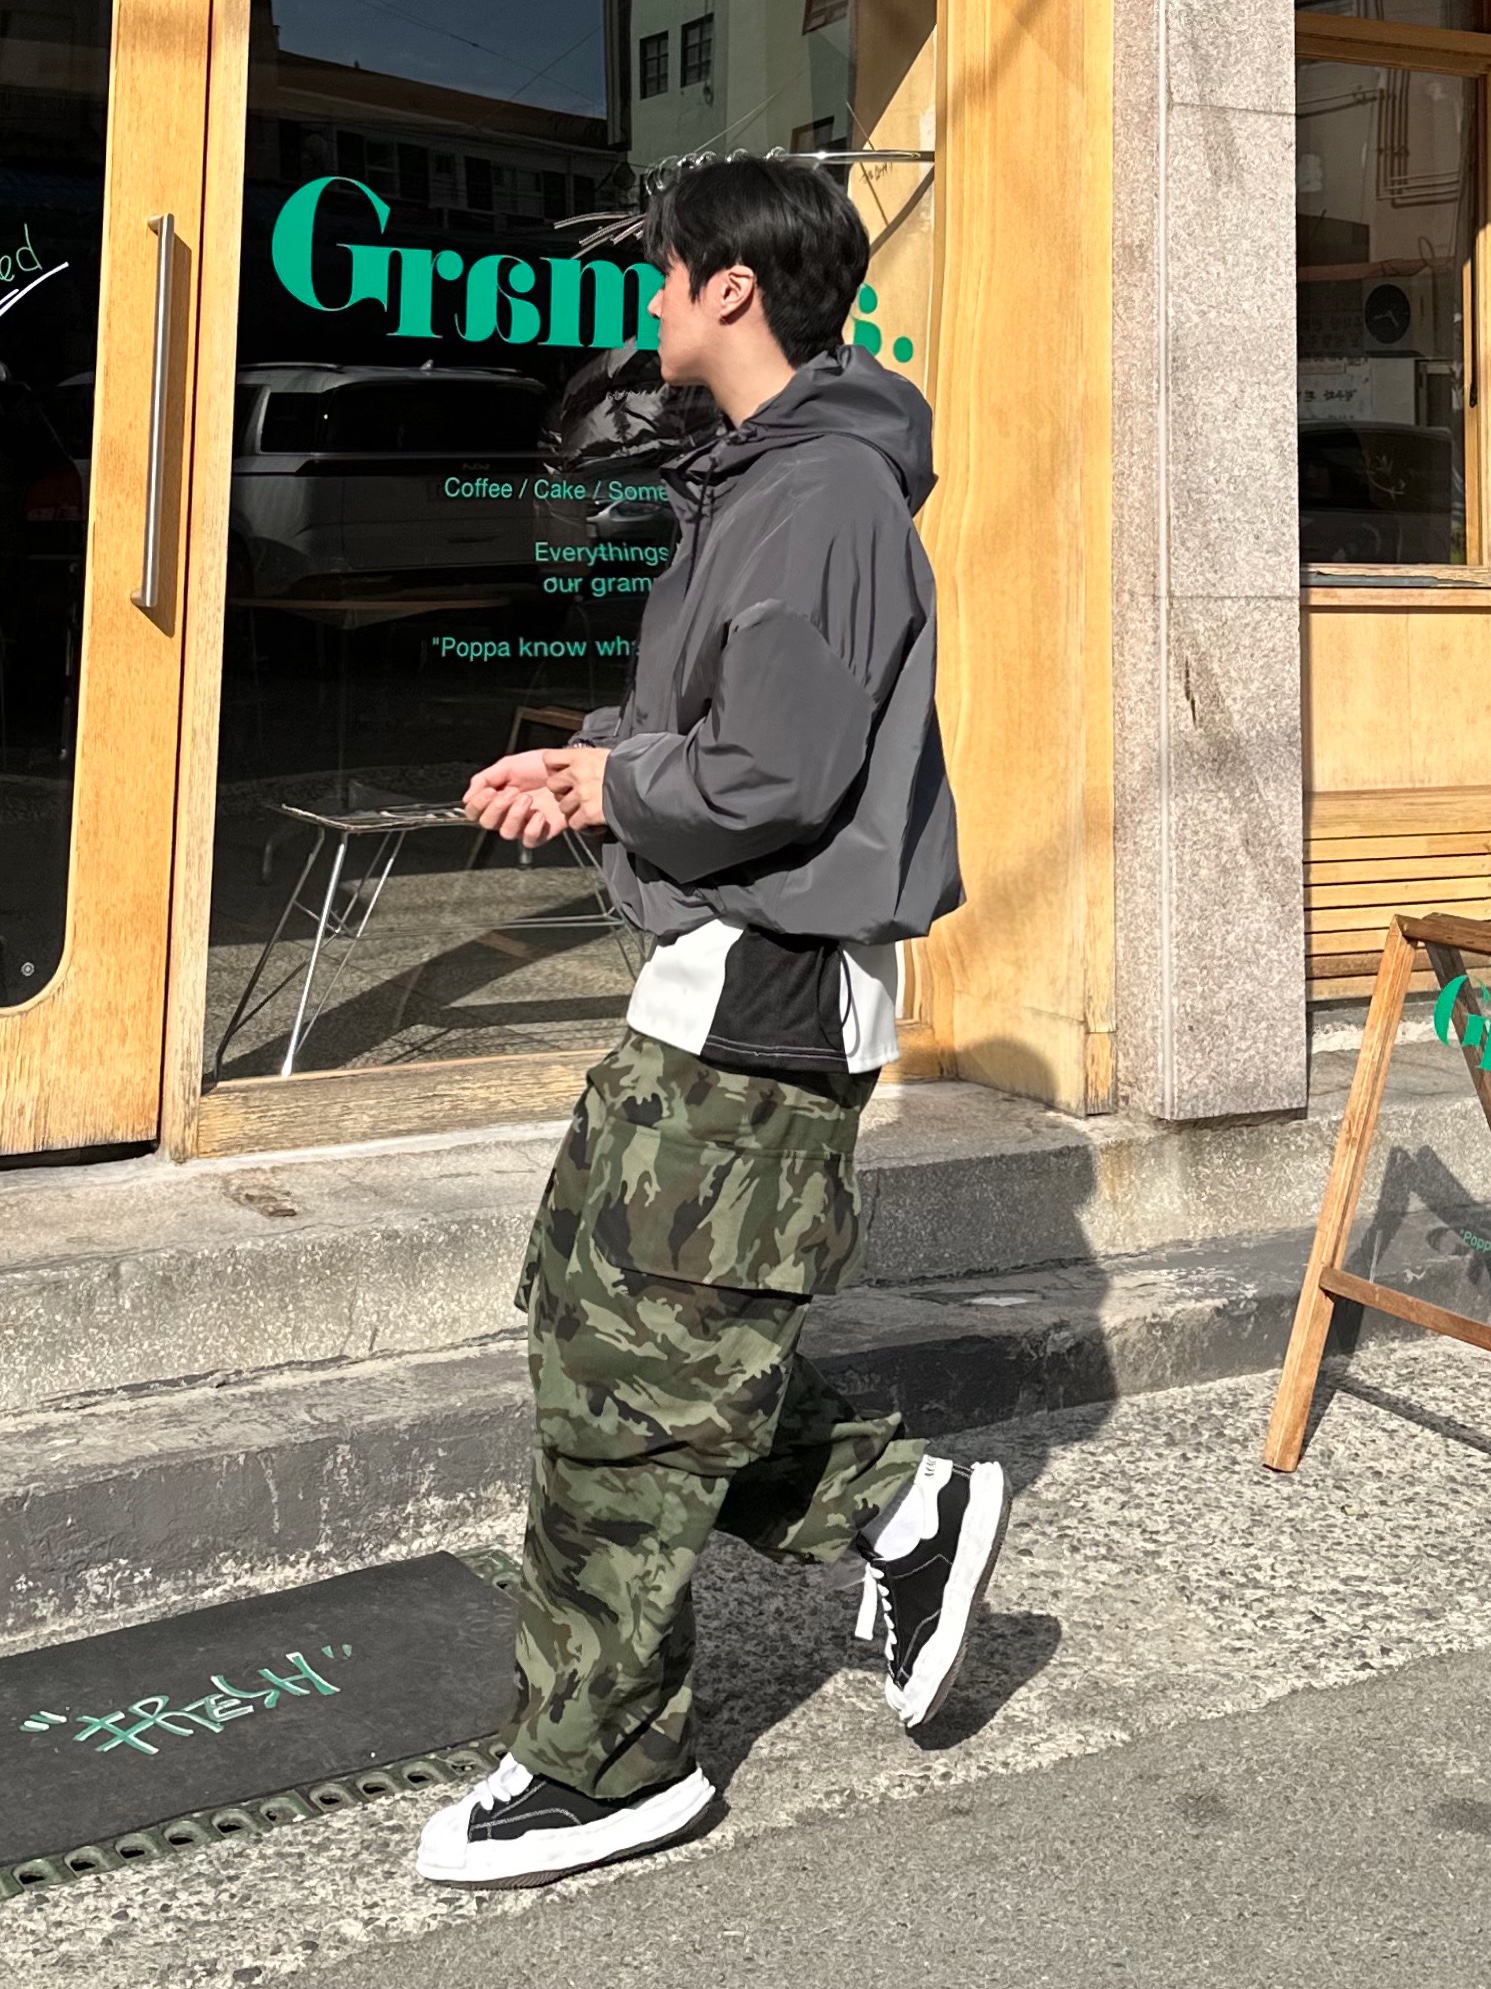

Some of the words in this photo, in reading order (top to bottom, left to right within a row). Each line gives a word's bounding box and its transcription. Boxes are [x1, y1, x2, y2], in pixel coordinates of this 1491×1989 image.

[444, 477, 513, 498] Coffee
[534, 479, 586, 499] Cake
[543, 576, 583, 593] our
[432, 636, 511, 662] "Poppa
[519, 637, 587, 657] know
